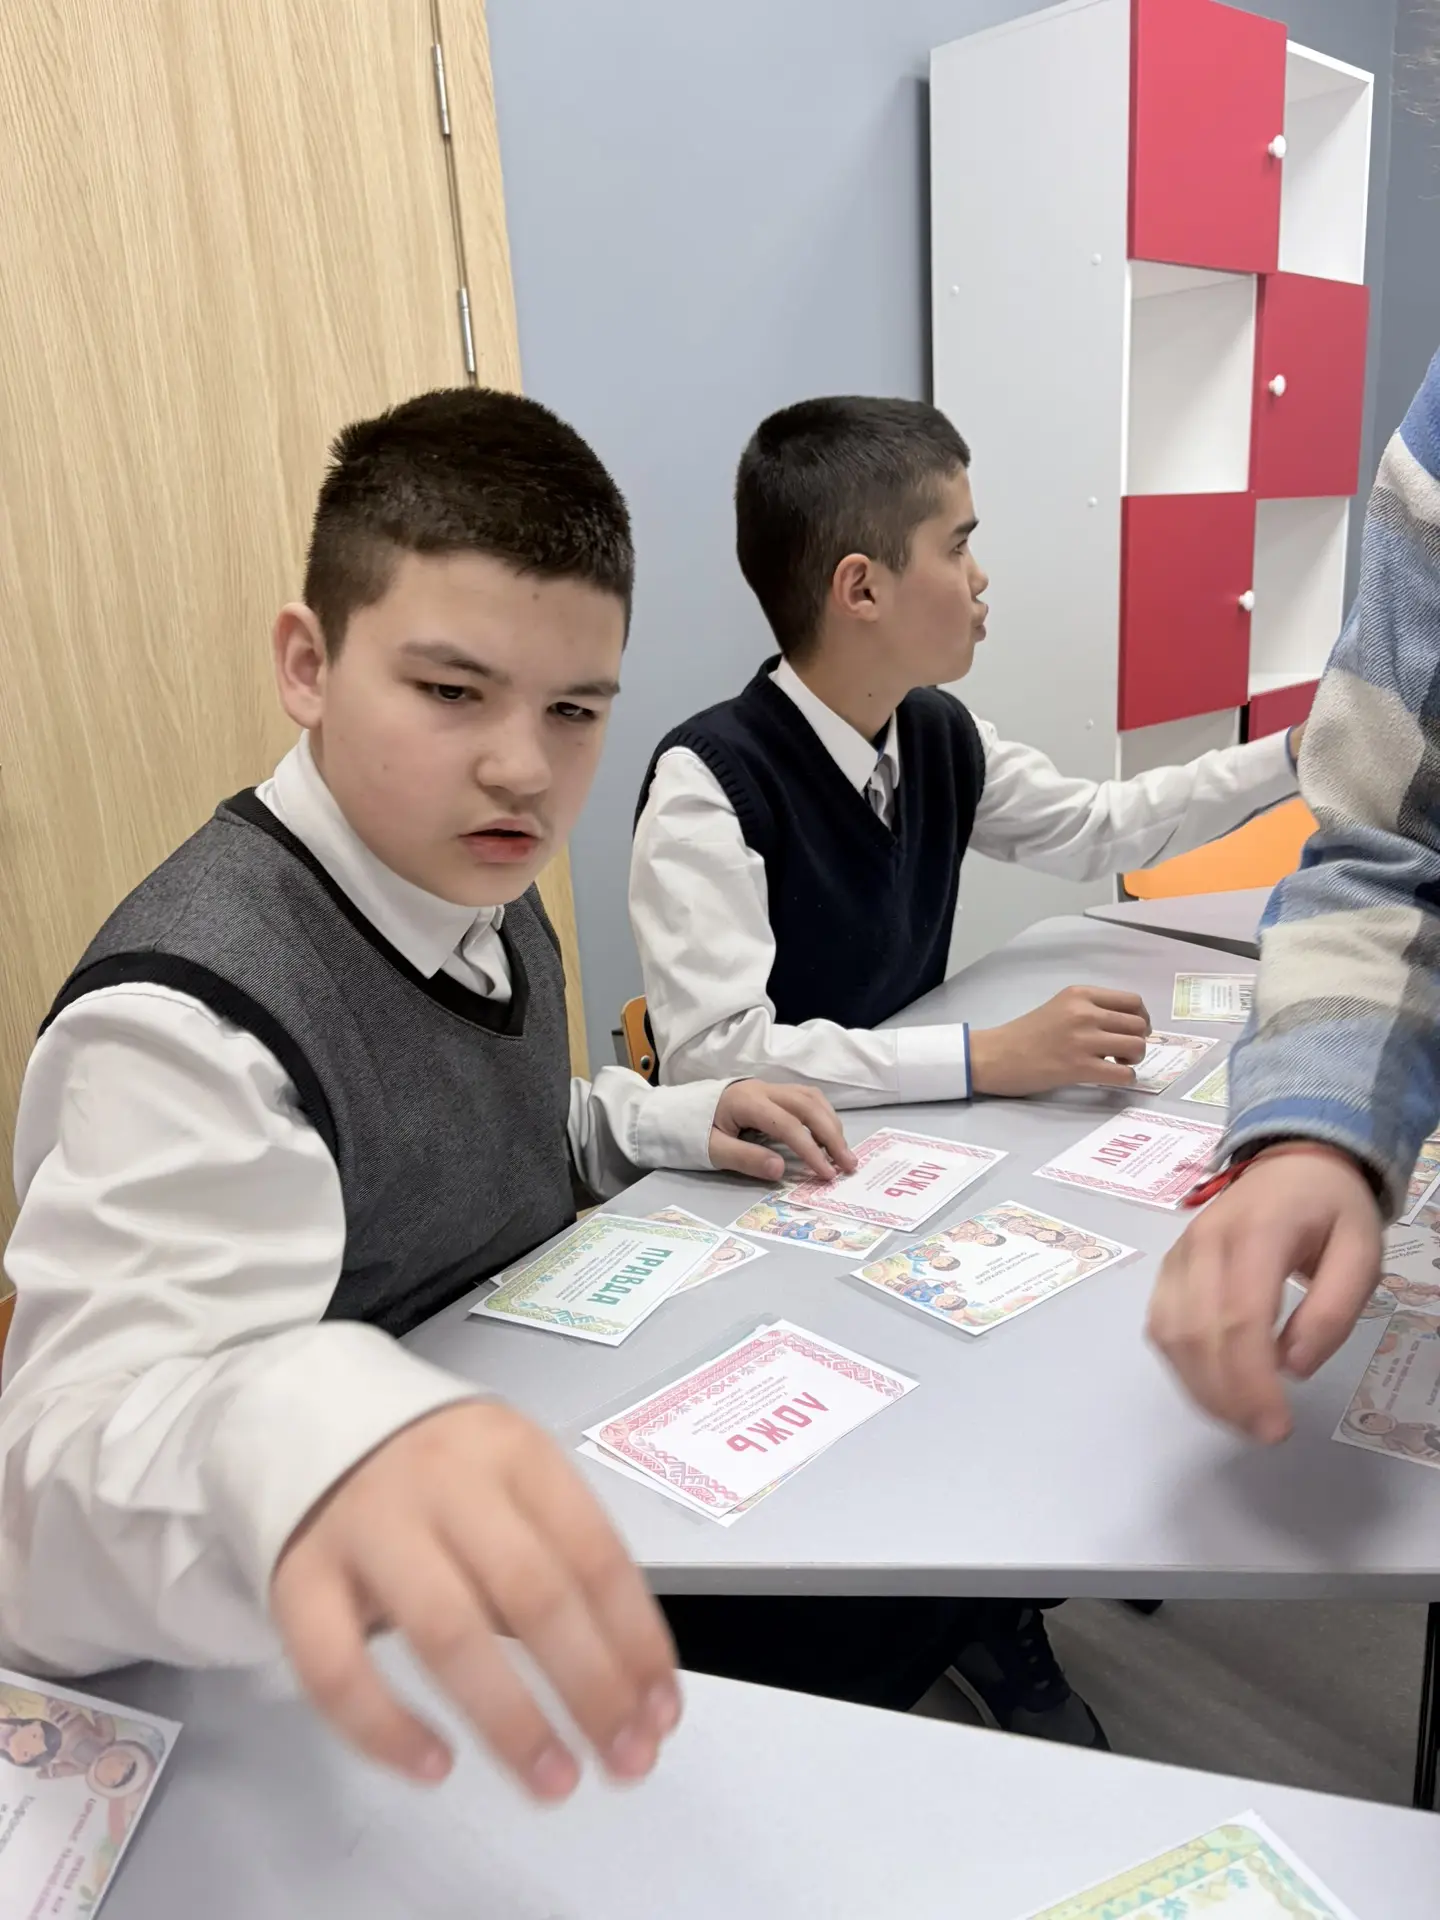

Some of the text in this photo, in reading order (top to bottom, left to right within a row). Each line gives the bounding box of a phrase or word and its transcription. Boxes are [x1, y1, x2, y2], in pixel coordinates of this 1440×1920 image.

[1090, 1133, 1152, 1166] ЛОЖЬ
[884, 1161, 948, 1198] ЛОЖЬ
[586, 1247, 674, 1306] ПРАВДА
[726, 1391, 829, 1453] ЛОЖЬ
